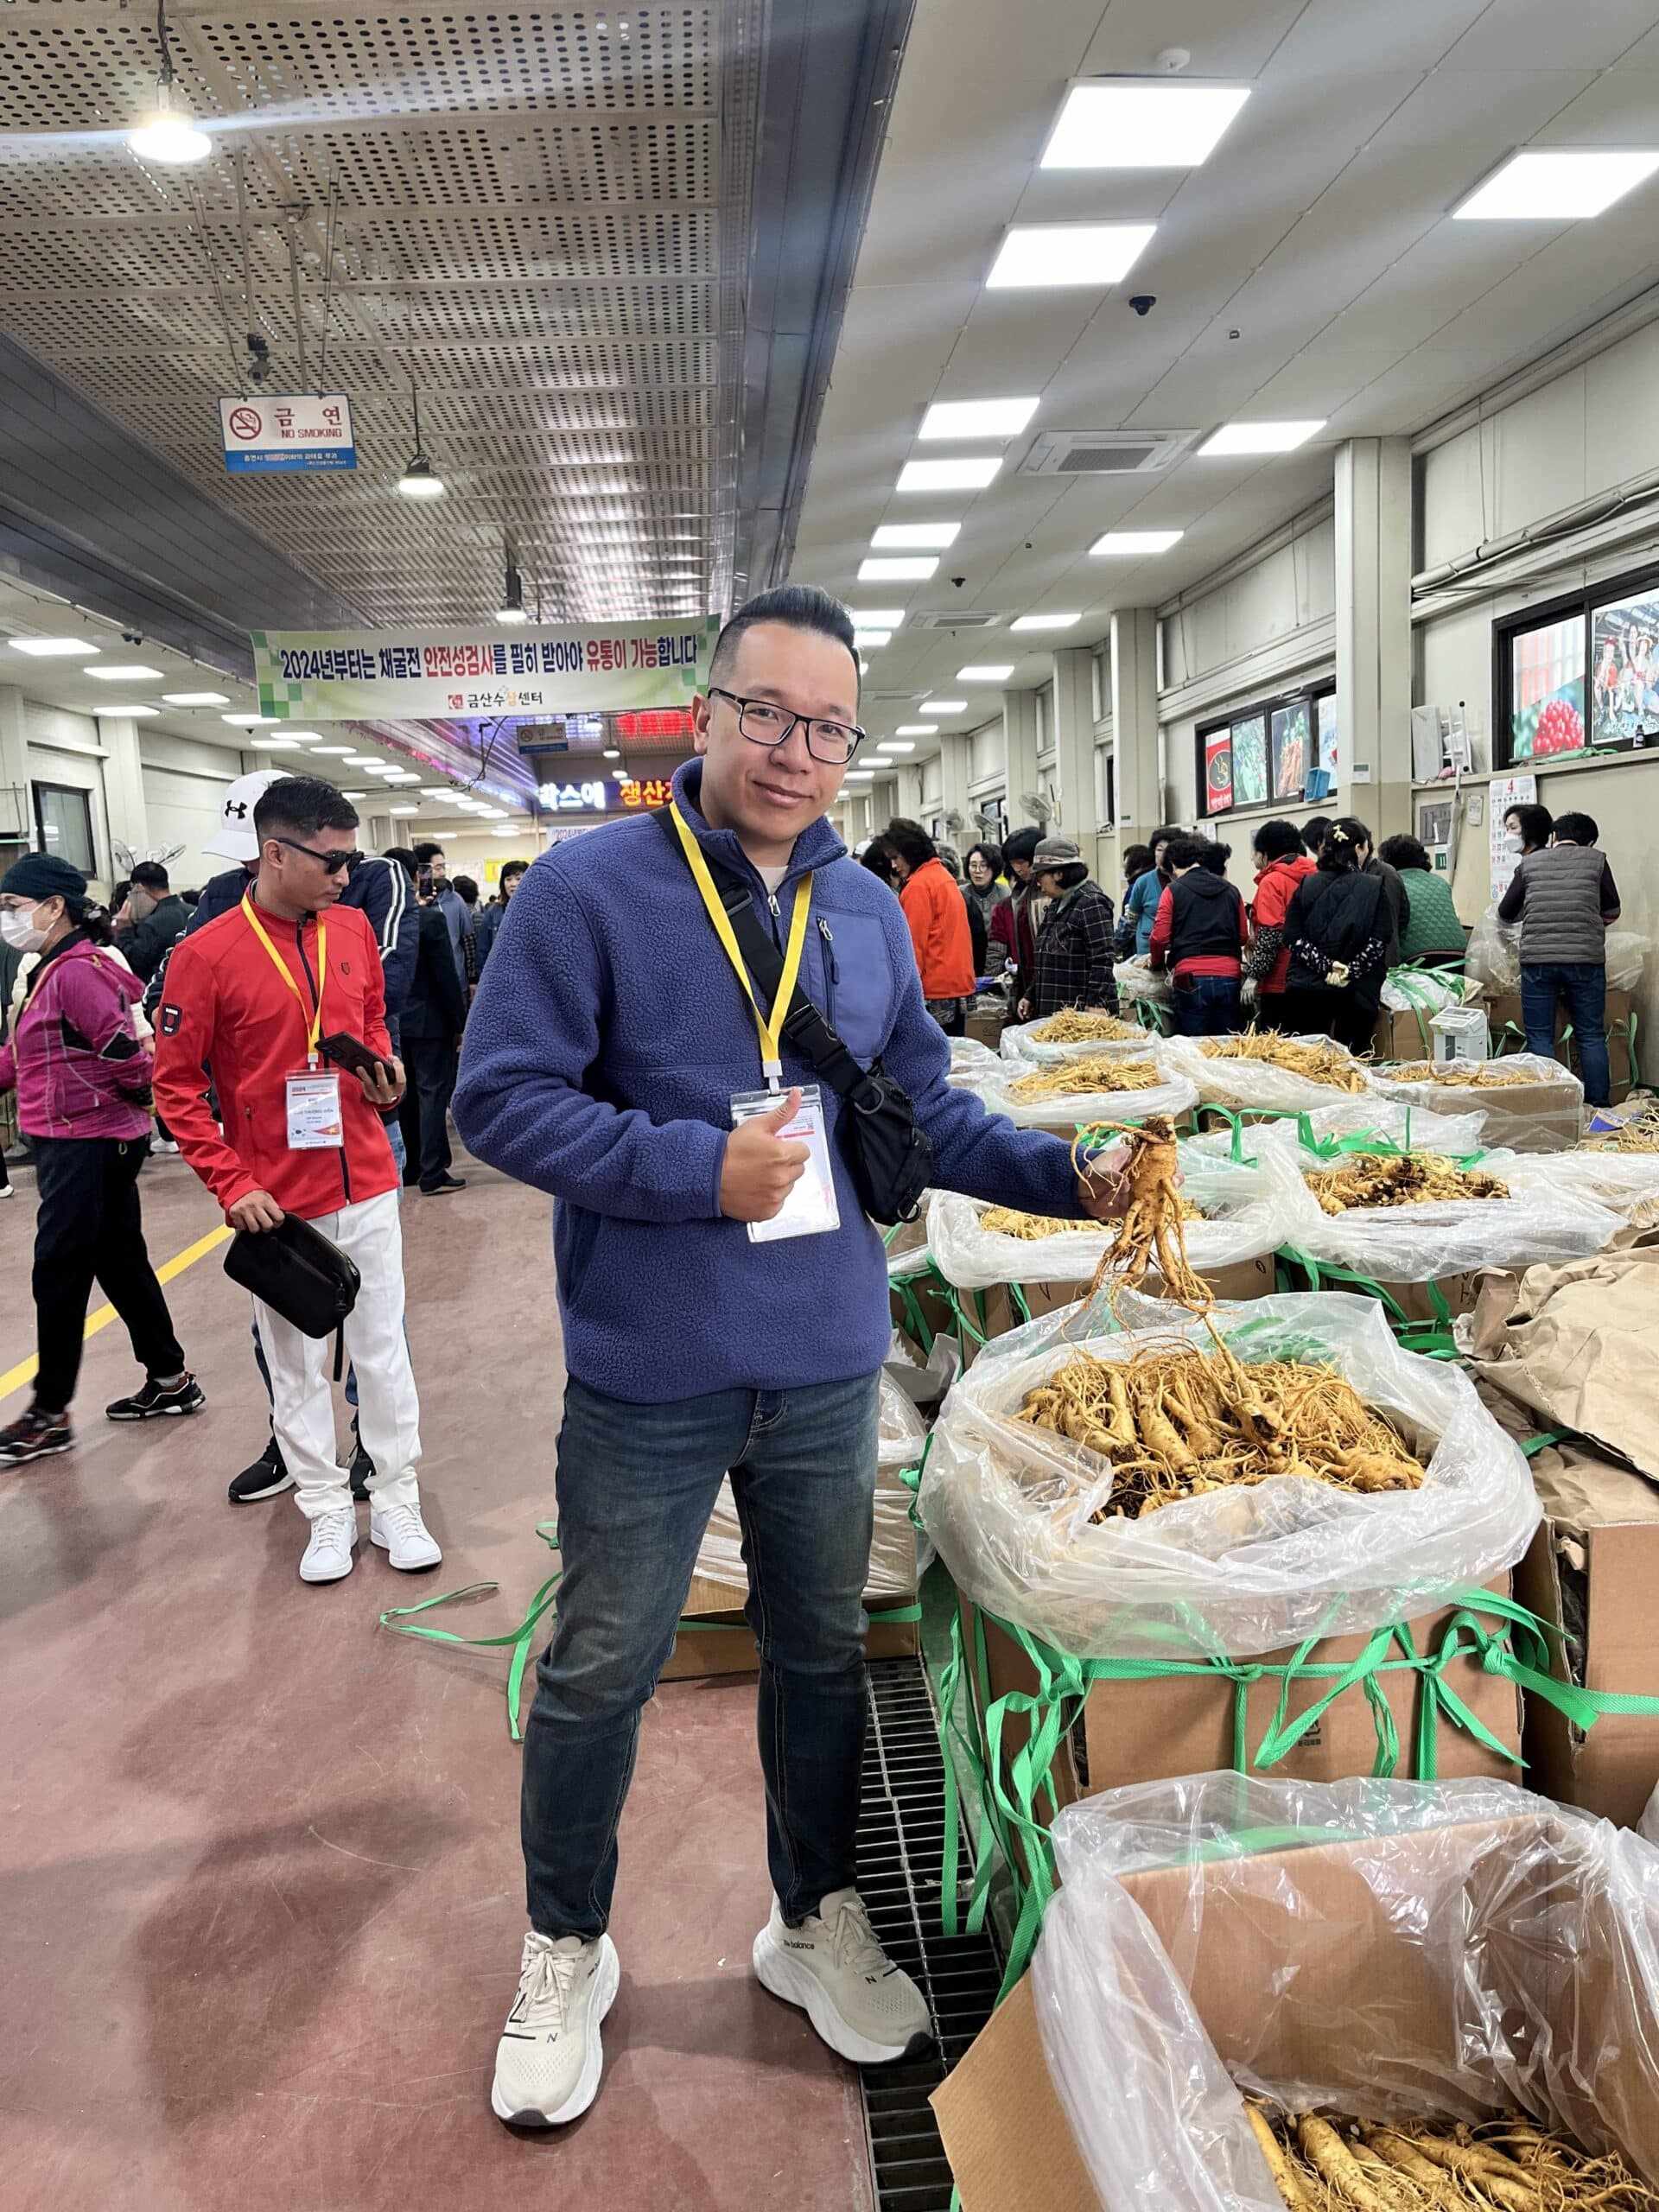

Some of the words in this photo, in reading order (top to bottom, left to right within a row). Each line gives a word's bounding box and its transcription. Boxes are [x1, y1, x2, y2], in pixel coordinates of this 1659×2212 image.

[281, 429, 295, 439] NO
[297, 429, 342, 438] SMOKING
[280, 648, 377, 681] 2024년부터는
[378, 646, 422, 679] 채굴전
[423, 643, 507, 677] 안전성검사를
[511, 642, 538, 674] 필히
[541, 640, 584, 673] 받아야
[587, 638, 627, 671] 유통이
[631, 634, 698, 669] 가능합니다
[467, 691, 543, 709] 금산수삼센터
[1507, 779, 1515, 793] 4
[791, 1940, 815, 1950] balance
